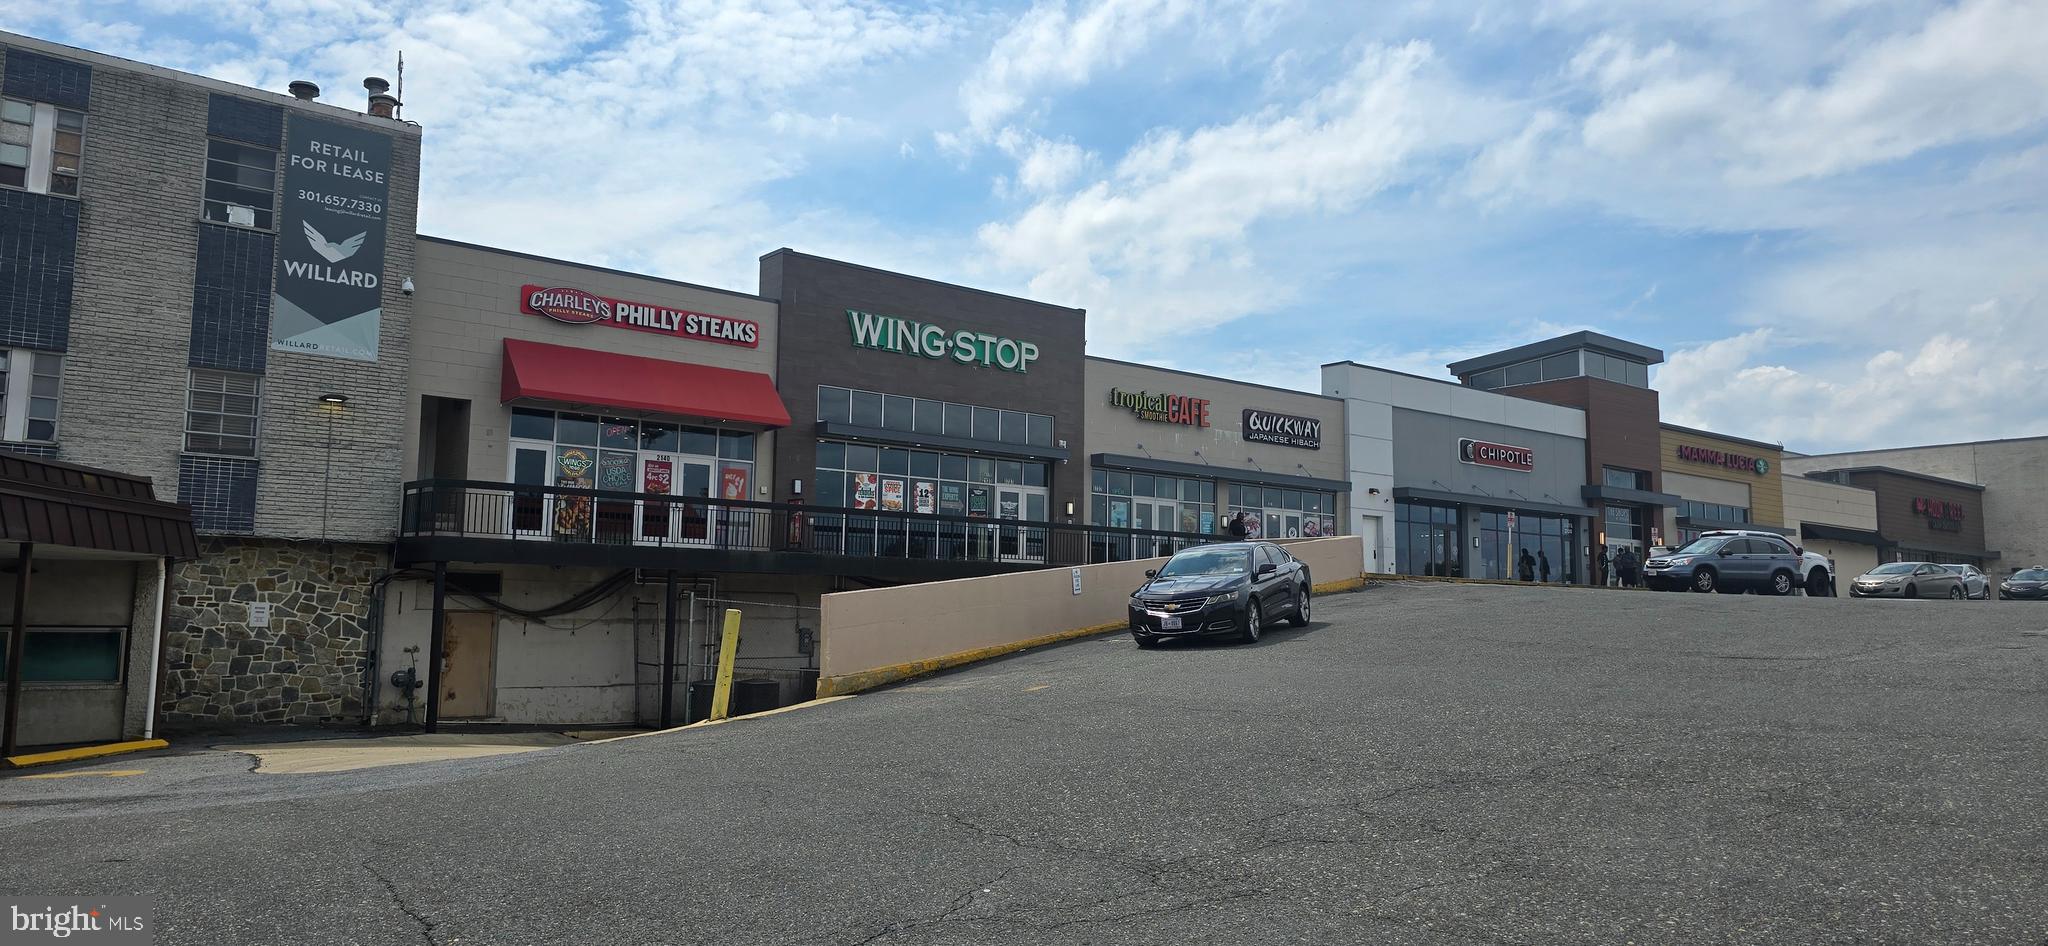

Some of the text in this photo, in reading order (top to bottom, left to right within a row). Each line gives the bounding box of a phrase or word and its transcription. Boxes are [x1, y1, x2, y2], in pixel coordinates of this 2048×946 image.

[311, 140, 369, 164] RETAIL
[291, 154, 385, 184] FOR LEASE
[298, 189, 382, 214] 301.657.7330
[283, 259, 378, 289] WILLARD
[532, 292, 757, 343] CHARLEYS PHILLY STEAKS
[1110, 386, 1211, 427] tropical CAFE
[1140, 410, 1168, 423] SMOOTHIE
[1249, 411, 1321, 438] QUICKWAY
[1249, 432, 1321, 448] JAPANESE HIBACH
[563, 457, 587, 468] WINGS
[1480, 446, 1533, 466] CHIPOTLE
[1681, 445, 1725, 466] MAMMA
[603, 472, 632, 484] CHOICE
[606, 466, 627, 476] USDA
[919, 488, 930, 498] 12
